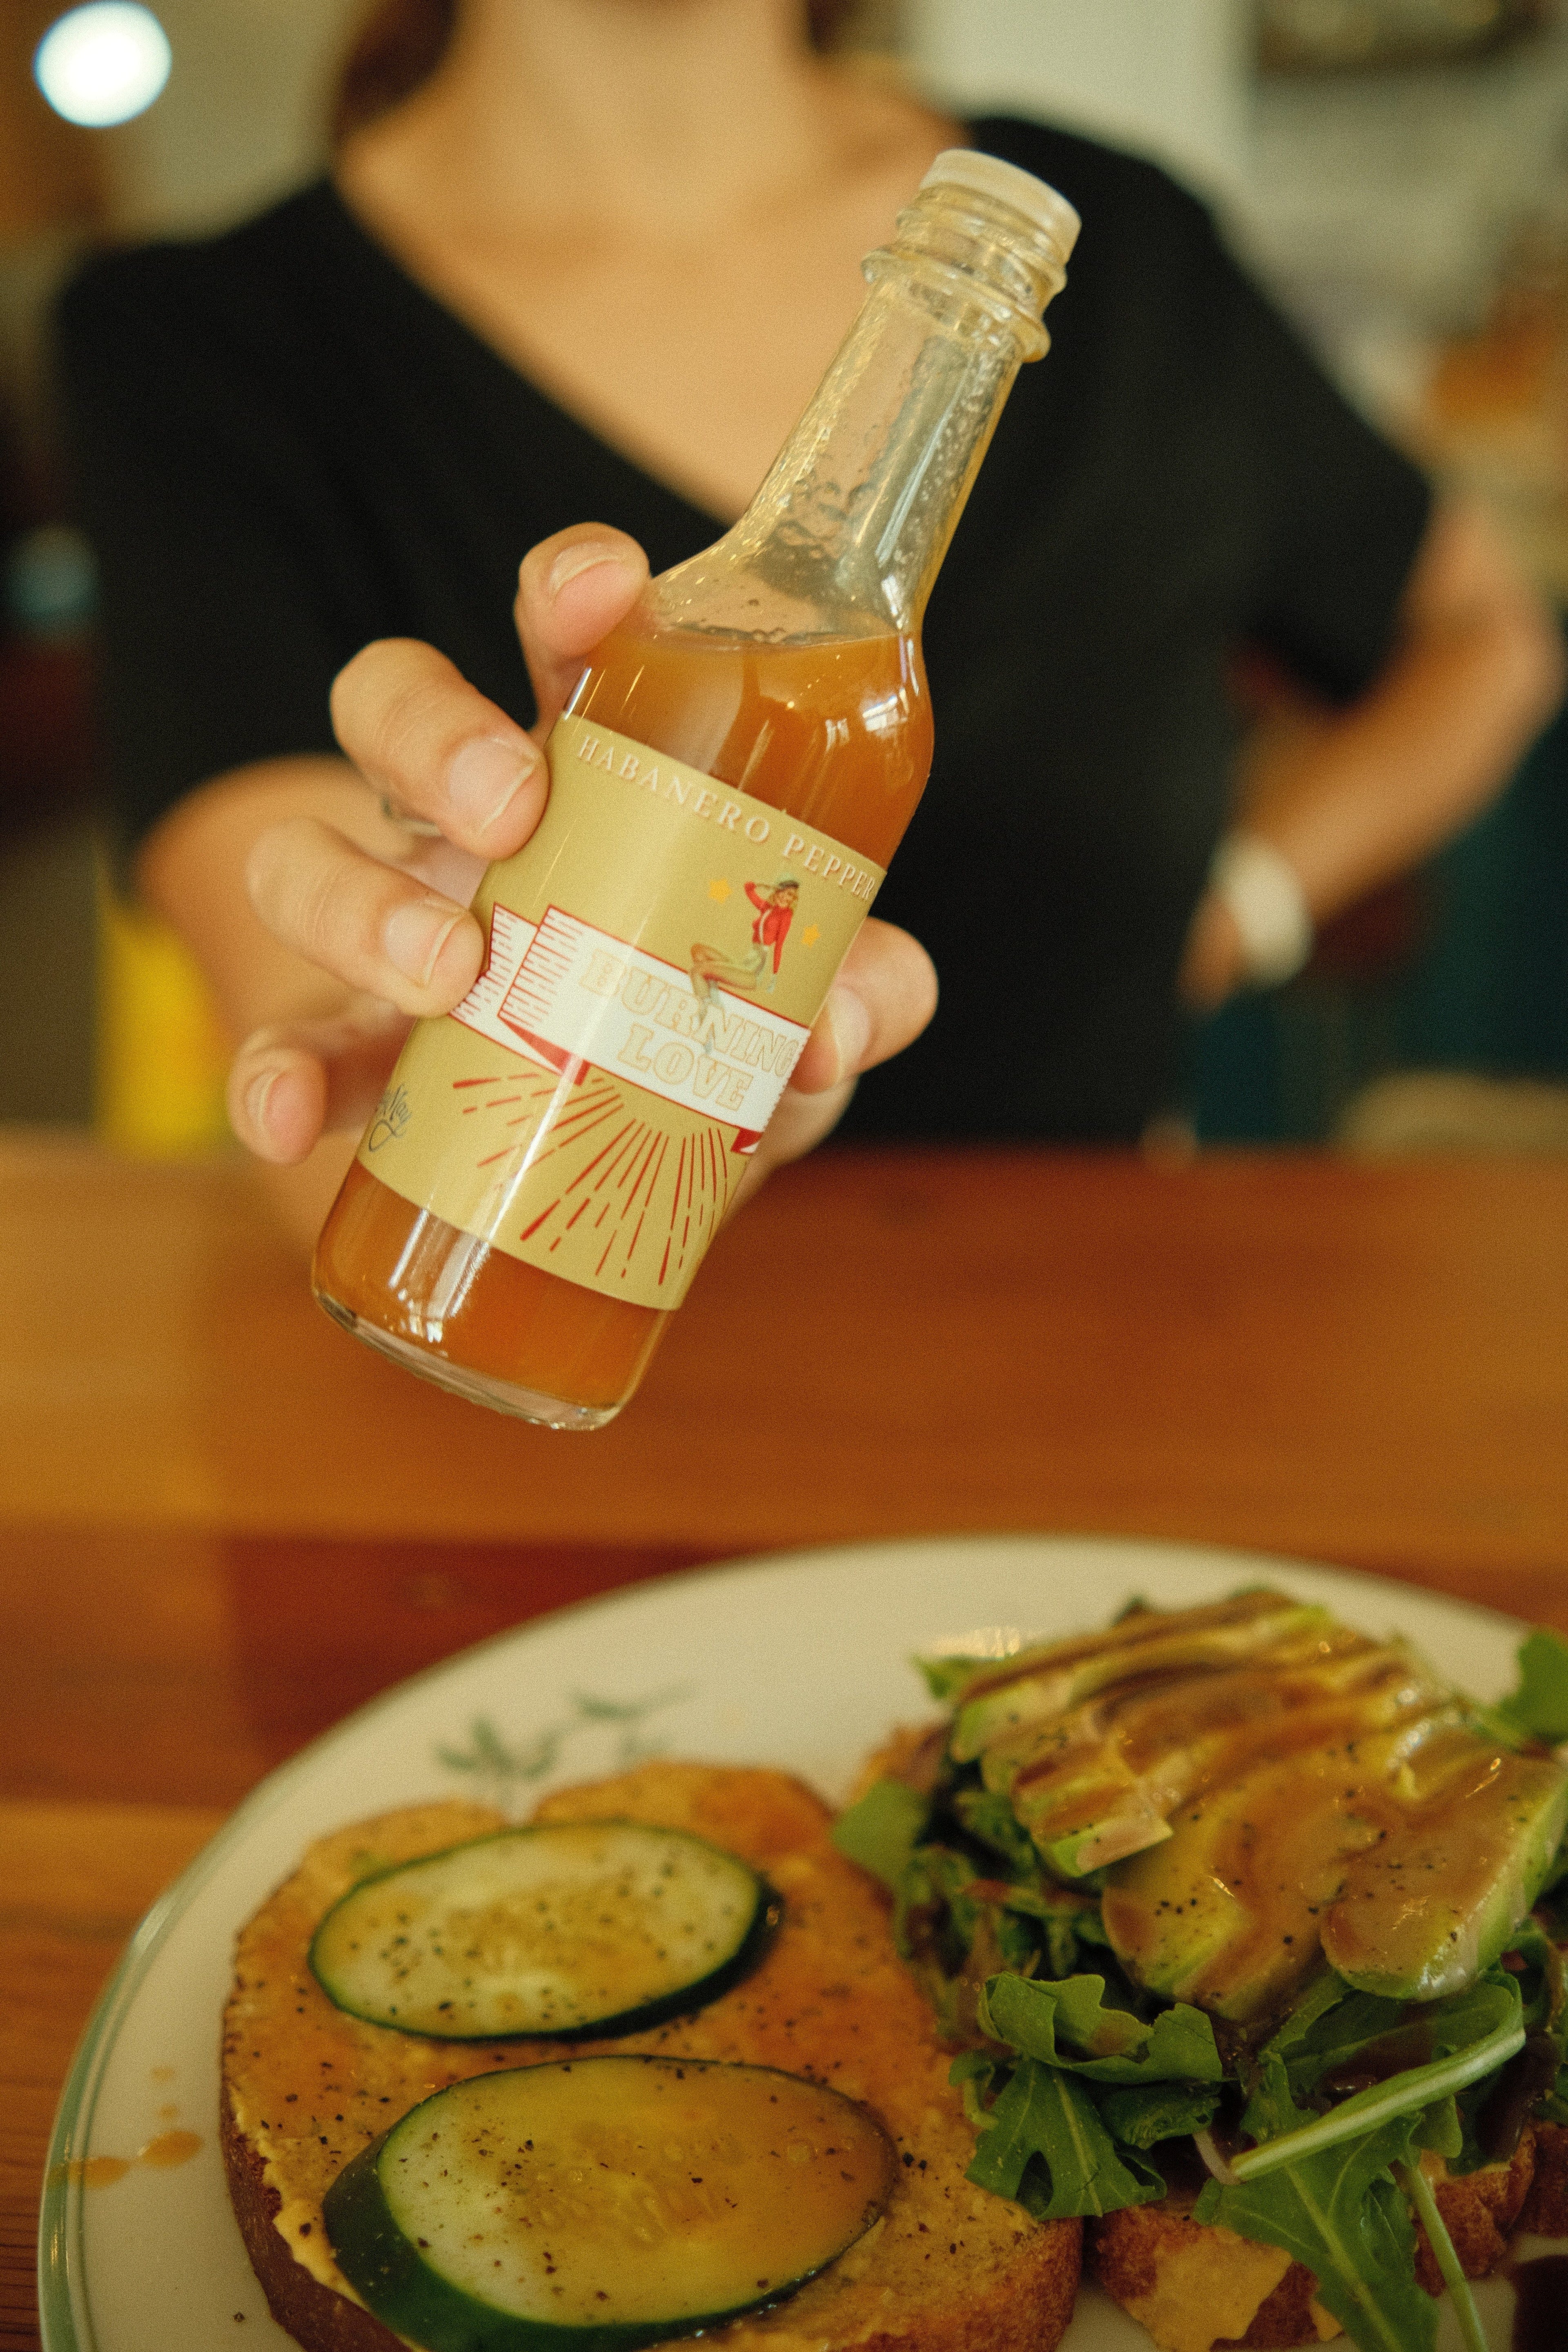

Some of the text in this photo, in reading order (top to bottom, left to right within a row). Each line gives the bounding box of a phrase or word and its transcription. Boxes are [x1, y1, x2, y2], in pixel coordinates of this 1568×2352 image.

[577, 736, 875, 900] HABANERO PEPPER
[578, 949, 799, 1078] BURNING
[617, 1022, 754, 1111] LOVE
